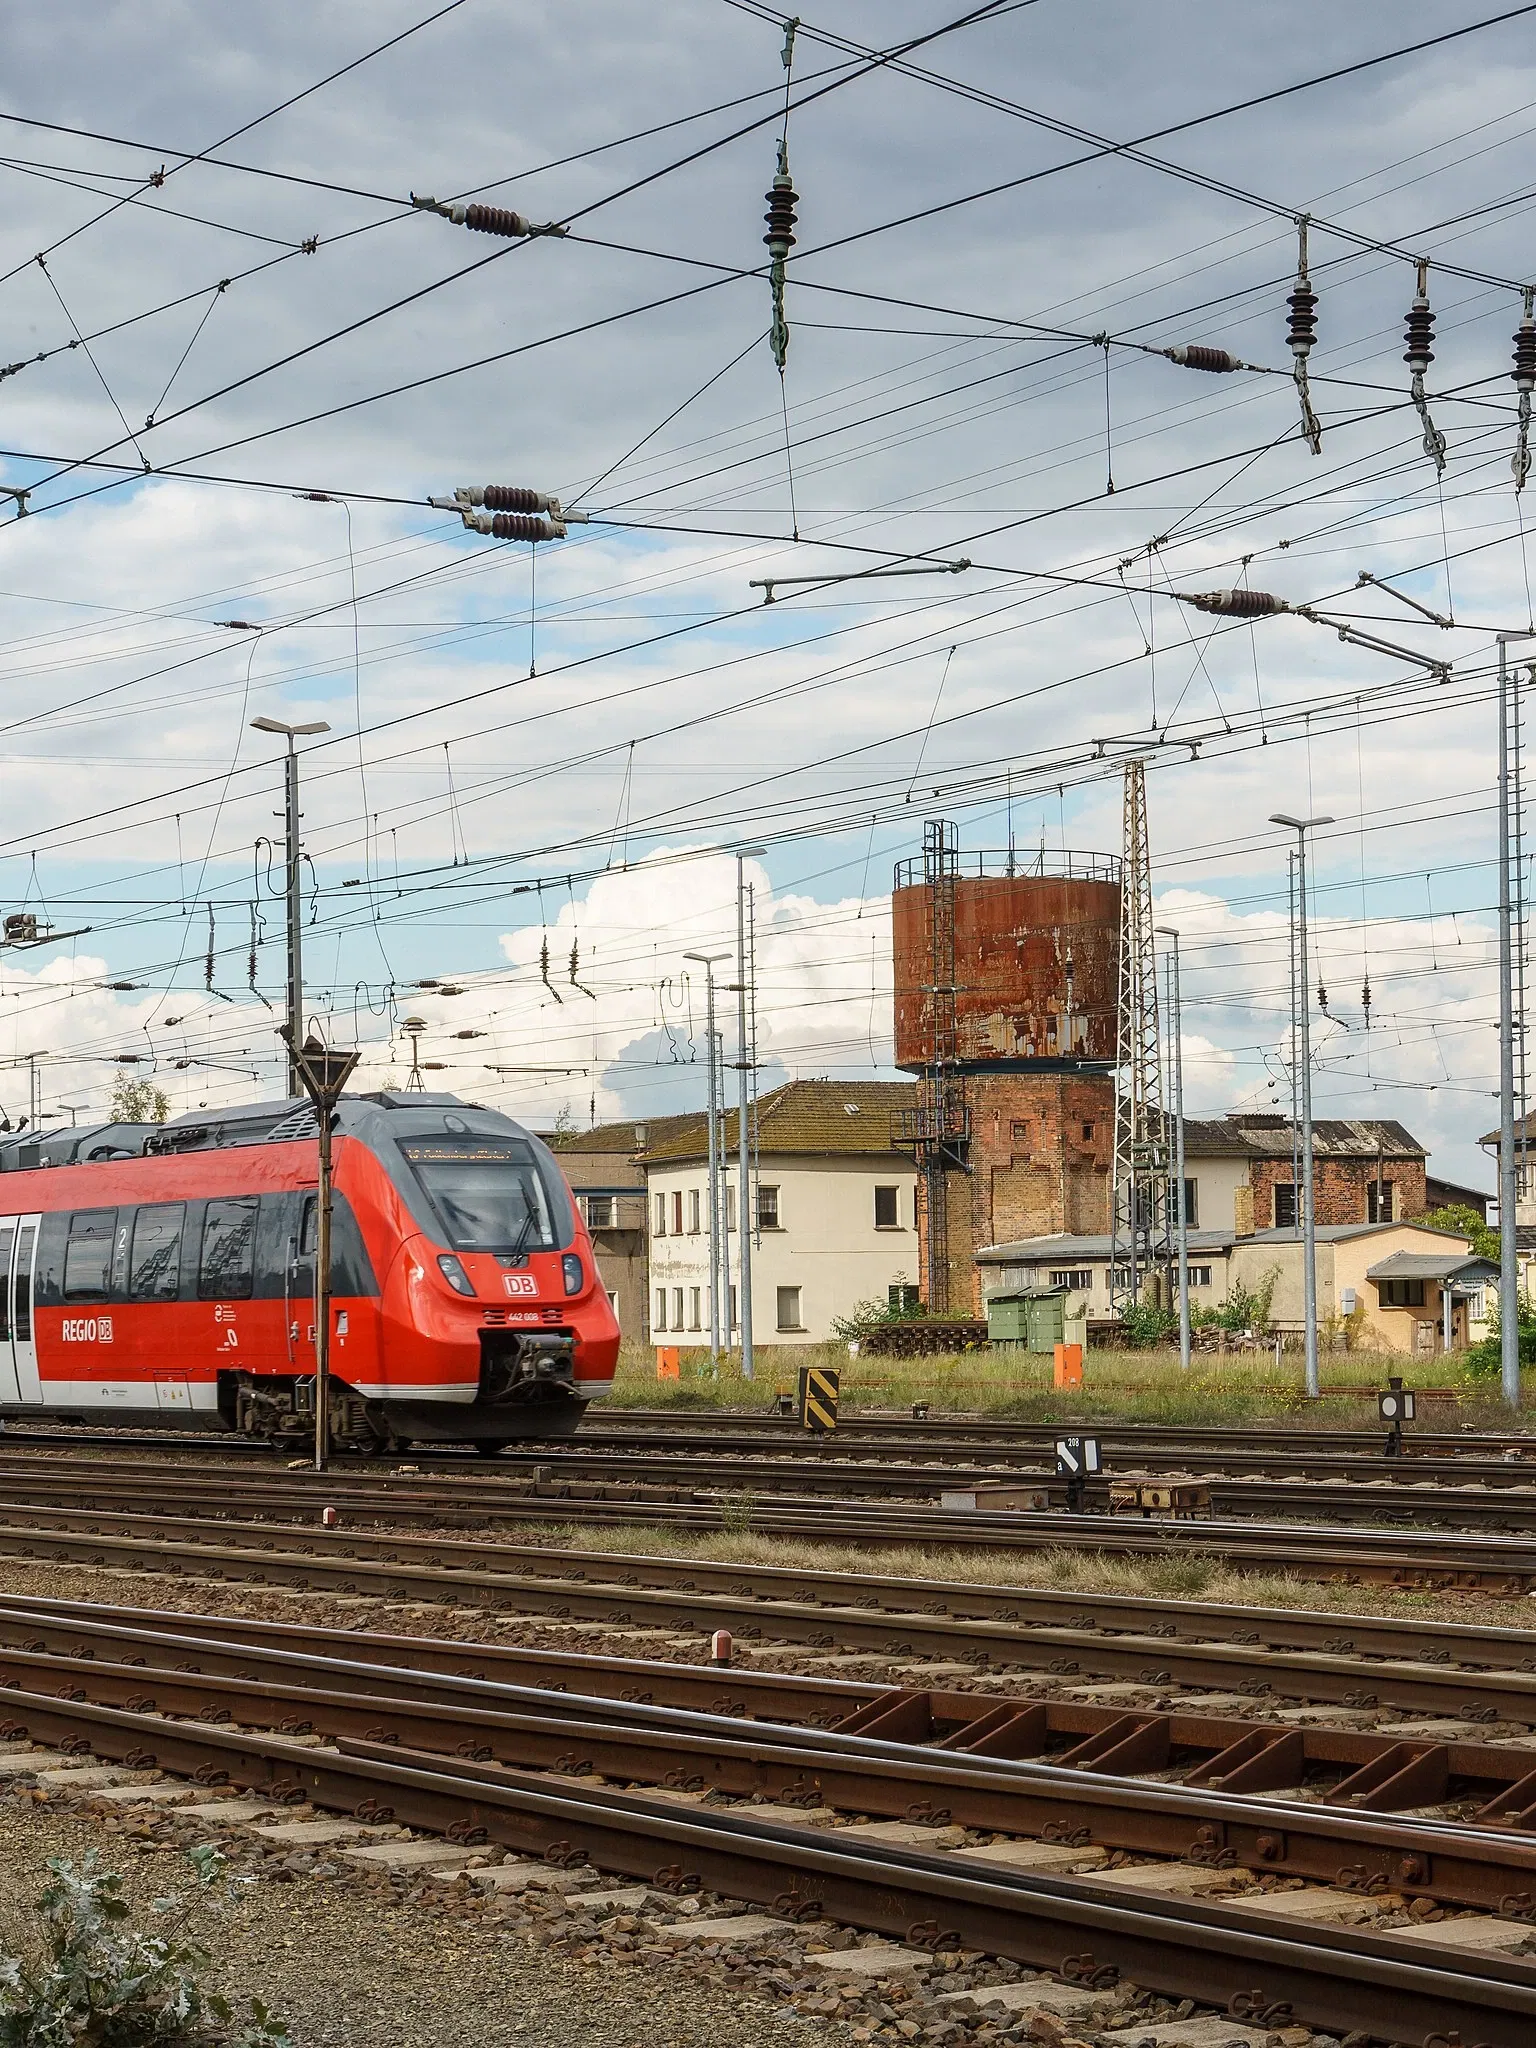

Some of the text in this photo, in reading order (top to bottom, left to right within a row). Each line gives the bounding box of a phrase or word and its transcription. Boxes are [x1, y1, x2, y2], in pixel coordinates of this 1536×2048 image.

[119, 1228, 127, 1248] 2
[506, 1276, 536, 1294] DB
[508, 1313, 523, 1321] 442
[62, 1319, 112, 1342] REGIO DB
[1057, 1461, 1063, 1471] a
